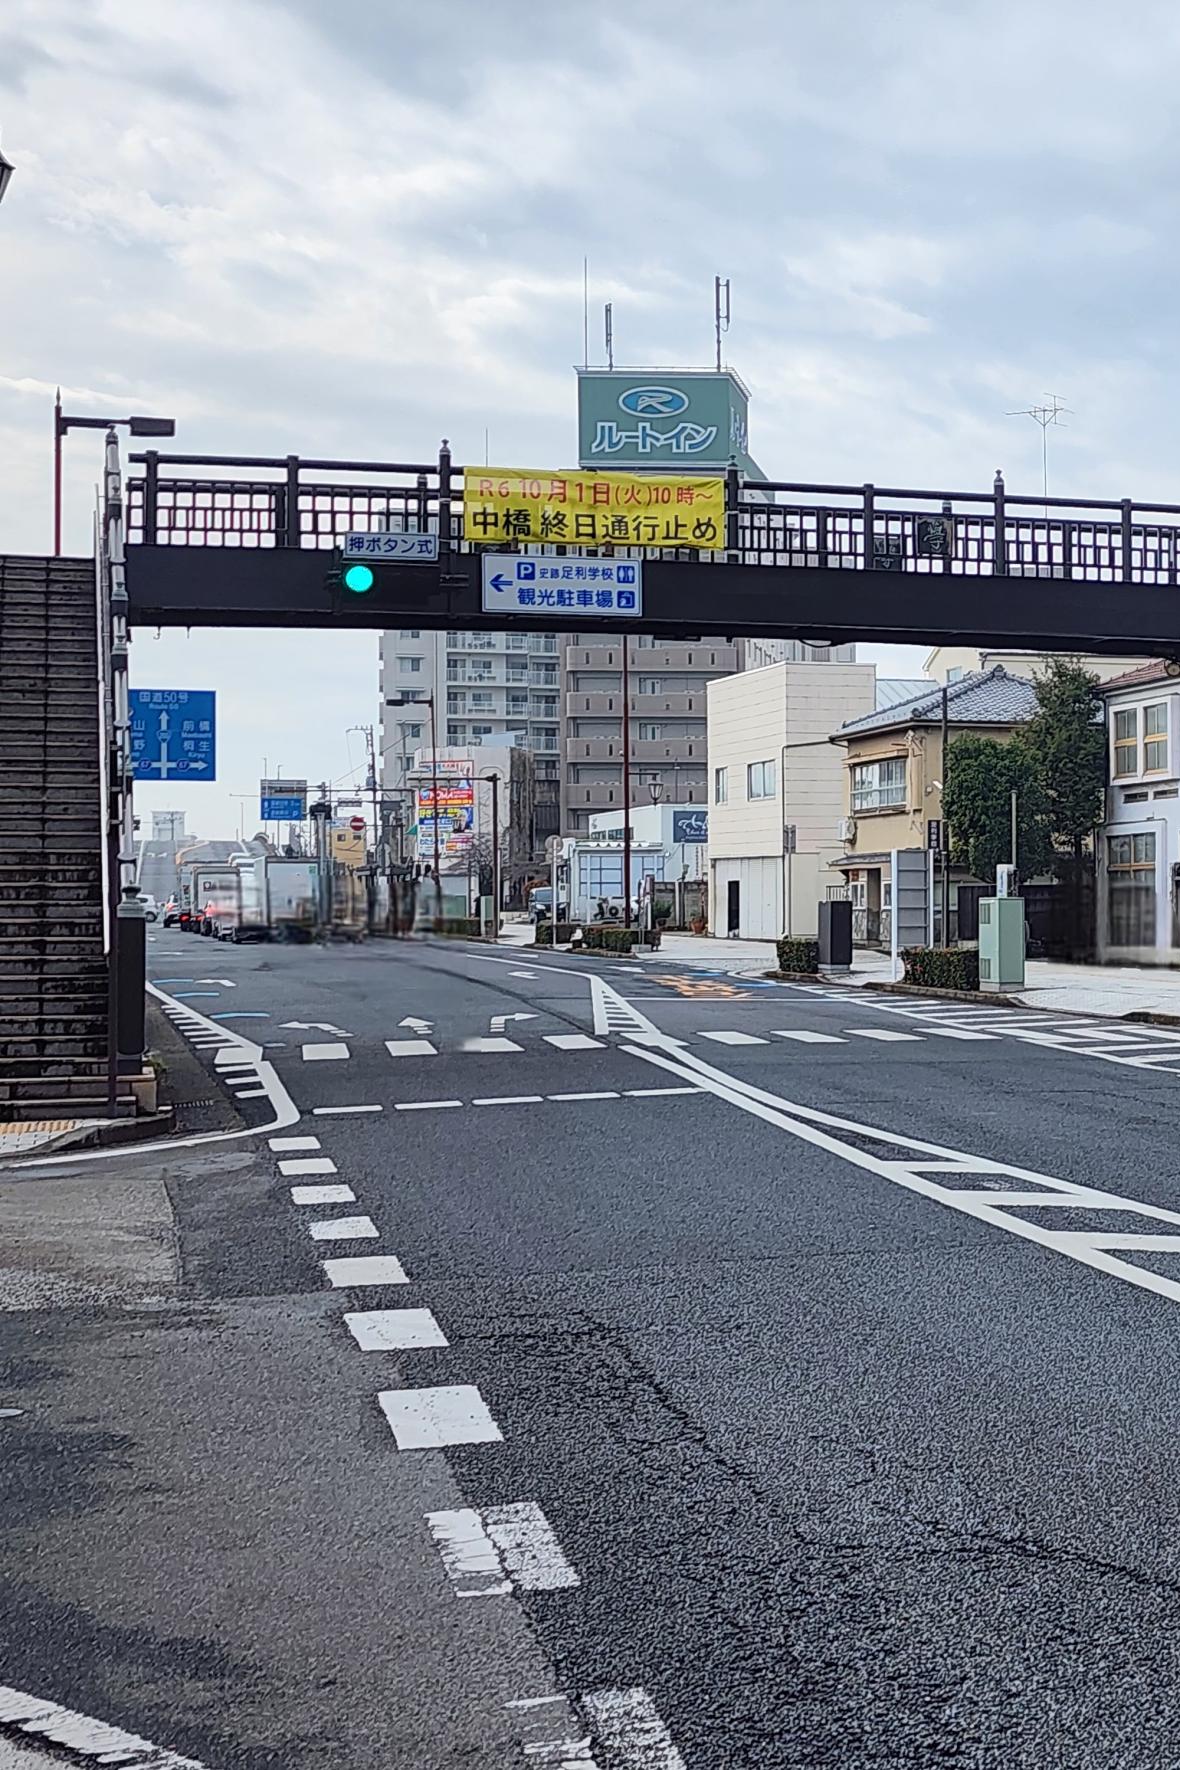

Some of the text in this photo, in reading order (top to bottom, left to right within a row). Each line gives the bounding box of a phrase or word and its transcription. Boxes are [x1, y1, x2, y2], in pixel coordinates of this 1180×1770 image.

[591, 421, 717, 453] ルートイン
[479, 479, 510, 498] R6
[349, 536, 433, 554] 押ボタン式
[517, 587, 614, 609] 観光駐車場
